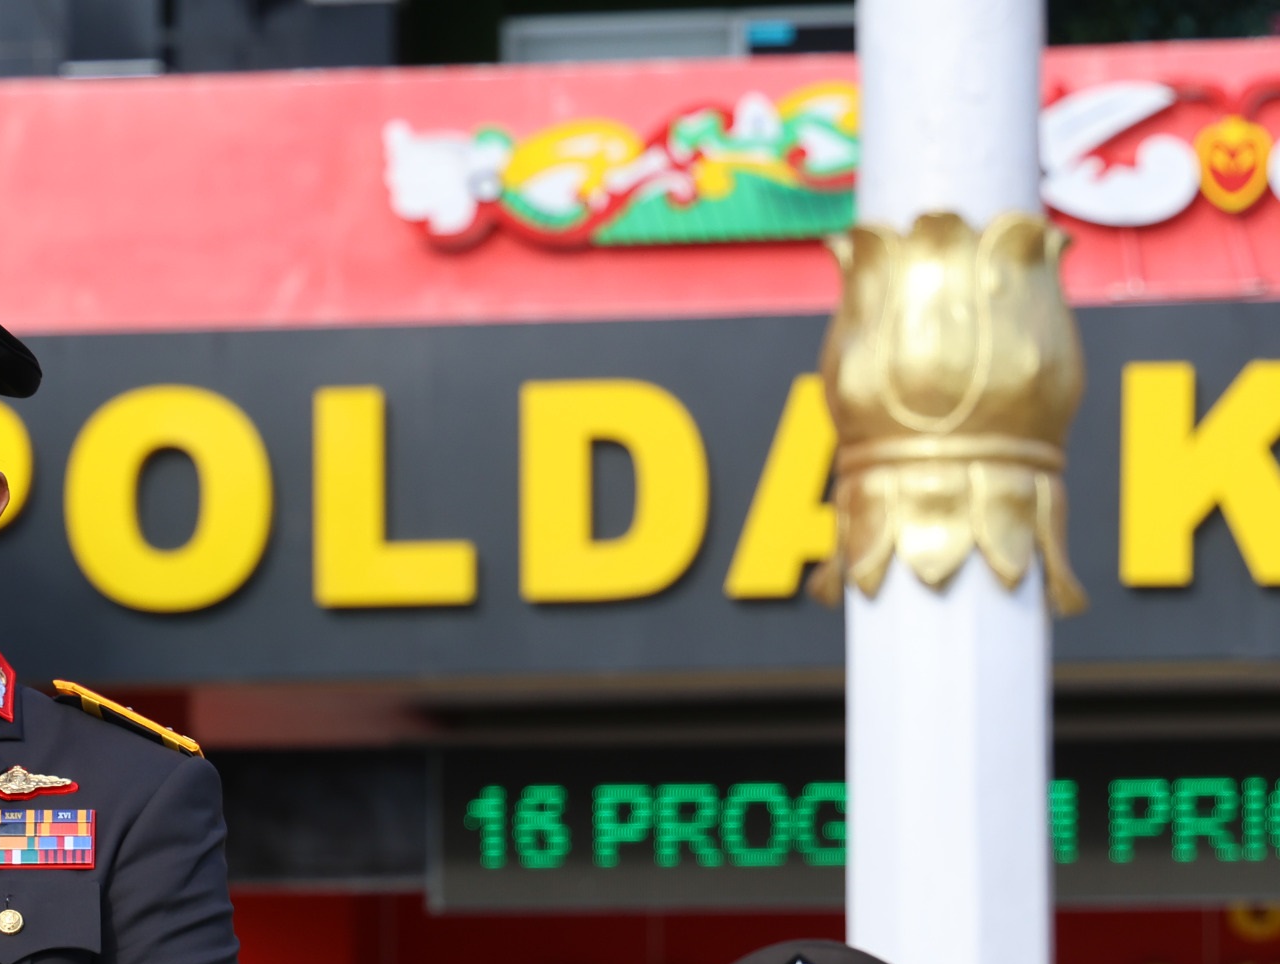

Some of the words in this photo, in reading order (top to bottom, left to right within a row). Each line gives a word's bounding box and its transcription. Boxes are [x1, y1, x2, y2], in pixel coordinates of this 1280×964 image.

[463, 785, 572, 869] 16
[592, 780, 1079, 869] PROG
[1108, 777, 1280, 864] PRI
